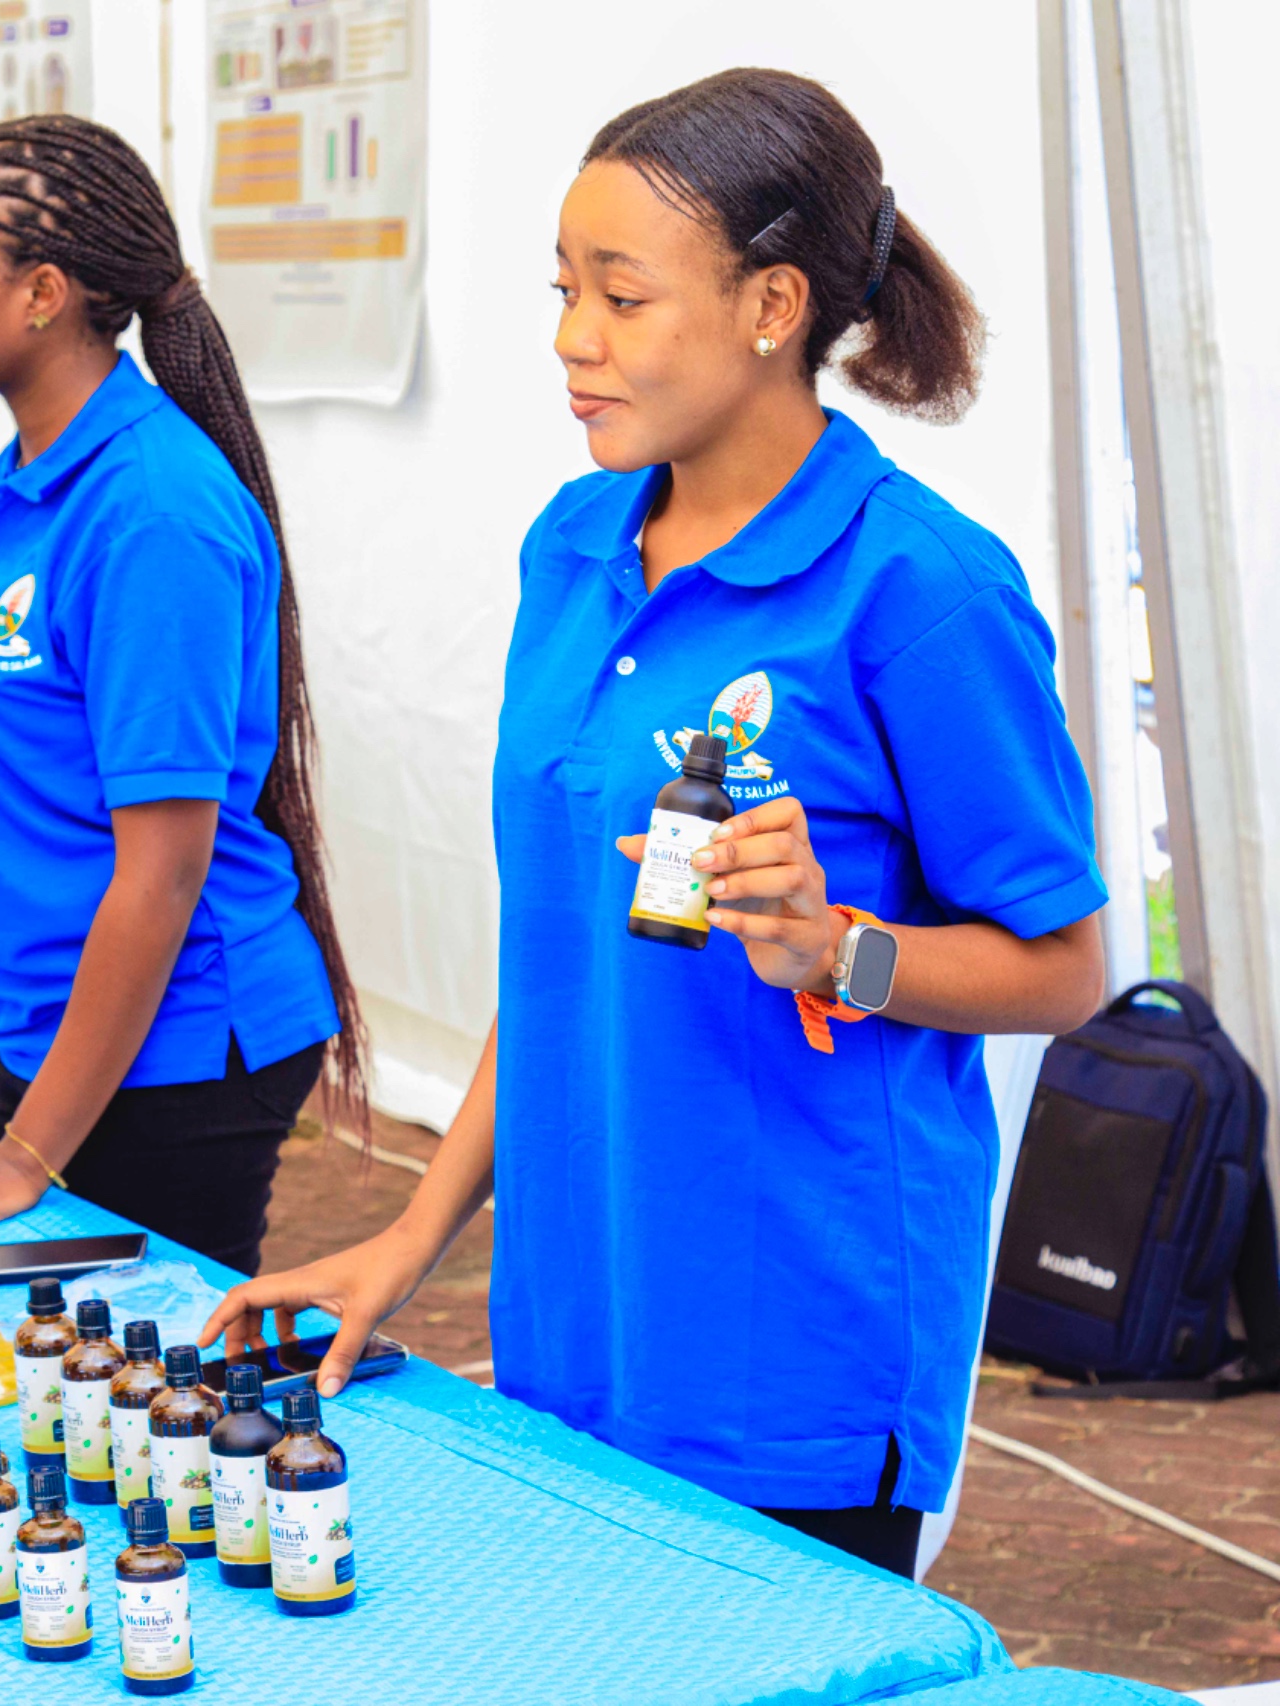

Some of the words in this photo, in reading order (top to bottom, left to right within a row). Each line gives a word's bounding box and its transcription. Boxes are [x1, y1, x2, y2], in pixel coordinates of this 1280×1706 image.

[652, 729, 682, 773] UNIVERSI
[729, 785, 742, 799] ES
[744, 779, 789, 799] SALAAM
[649, 846, 692, 867] MeliHer
[125, 1612, 174, 1627] MeliHerb
